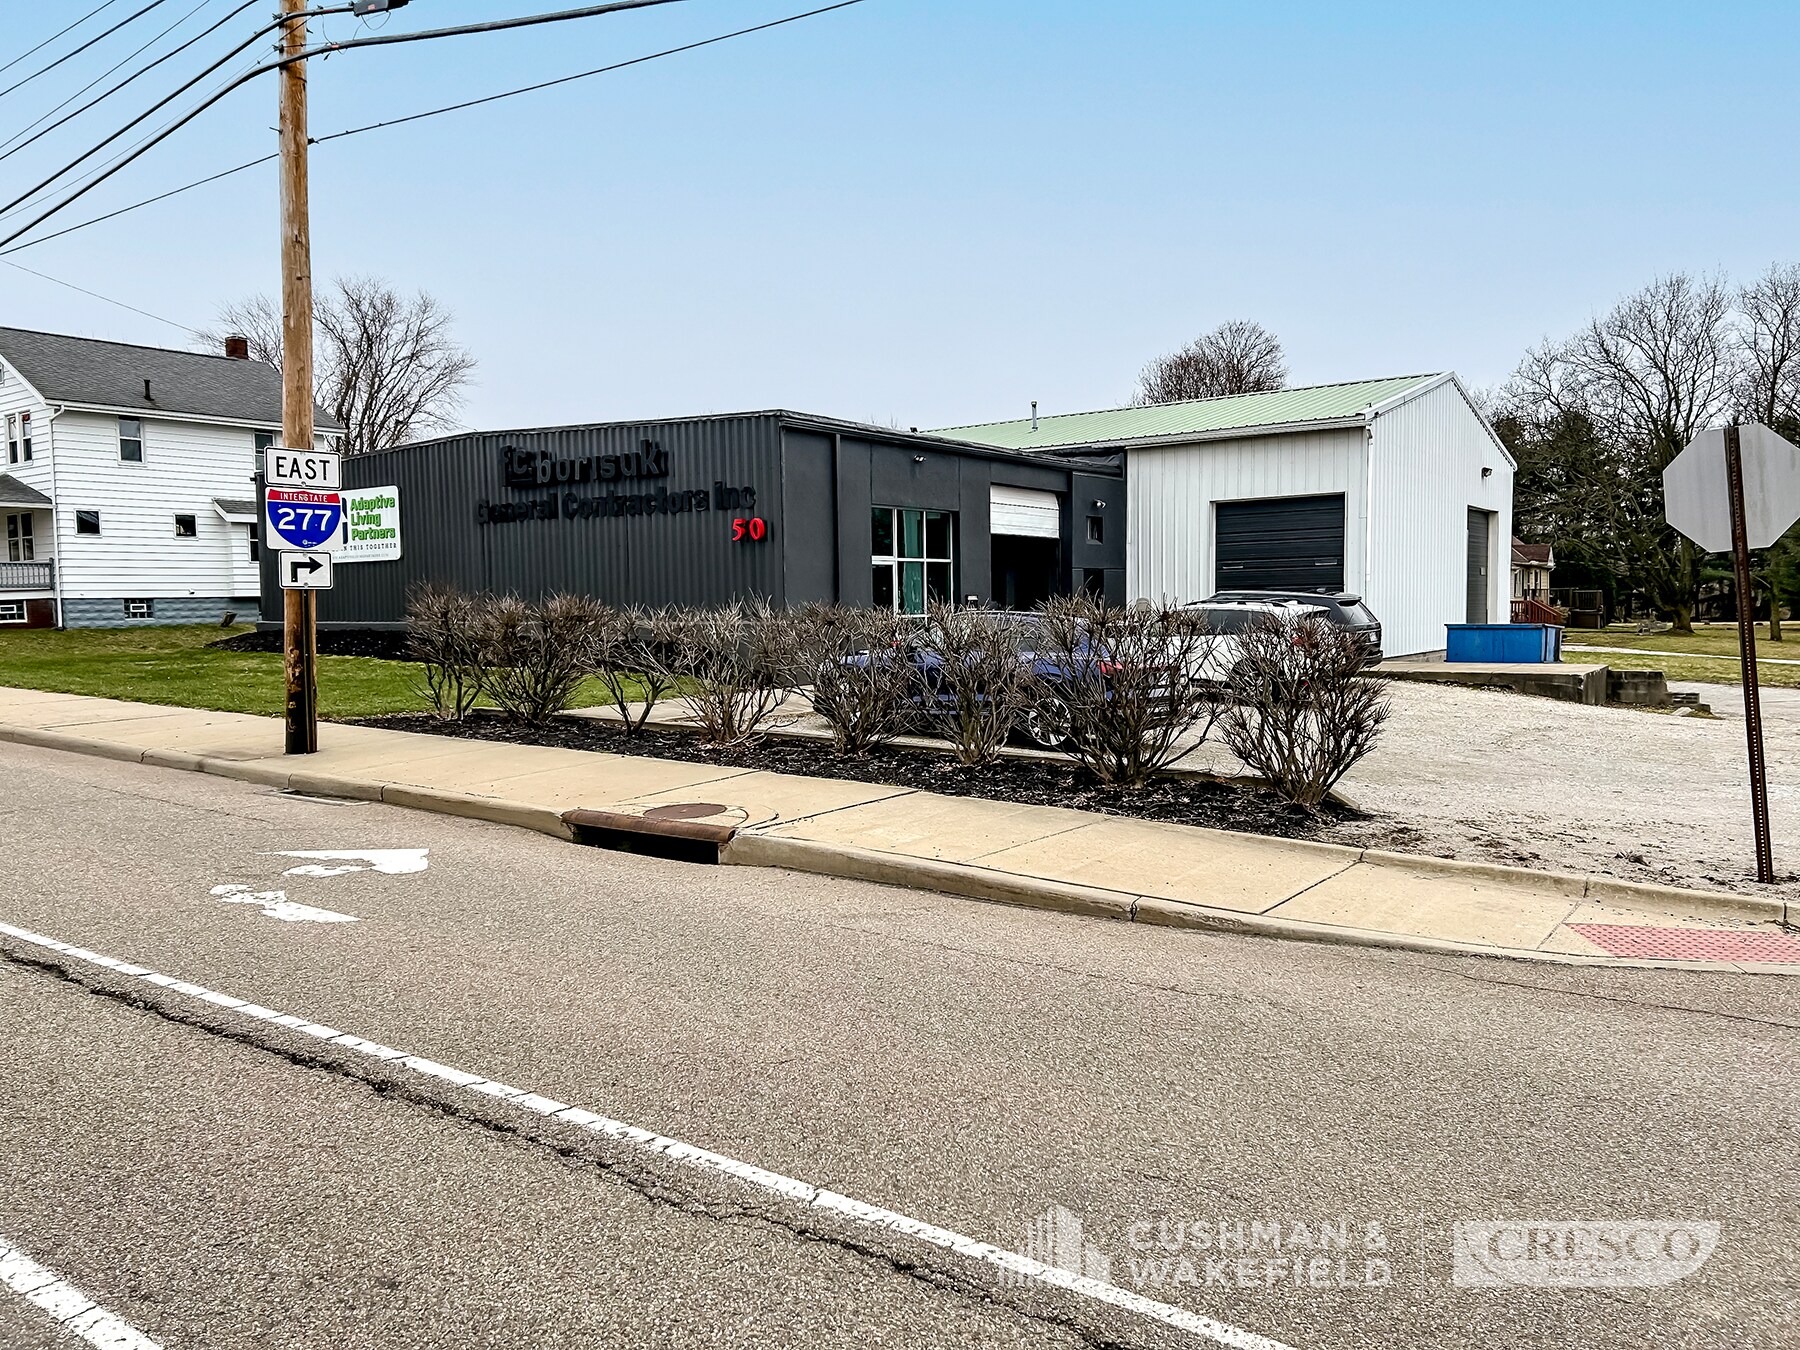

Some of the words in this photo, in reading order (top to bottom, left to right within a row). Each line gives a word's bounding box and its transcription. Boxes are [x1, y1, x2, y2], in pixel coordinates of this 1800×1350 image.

[275, 455, 331, 481] EAST
[280, 492, 328, 503] INTERSTATE
[350, 494, 396, 512] Adaptive
[476, 493, 559, 525] General
[562, 486, 710, 520] Contractors
[714, 480, 757, 511] Inc
[277, 507, 332, 531] 277
[350, 511, 382, 527] Living
[731, 517, 766, 541] 50
[351, 527, 396, 541] Partners
